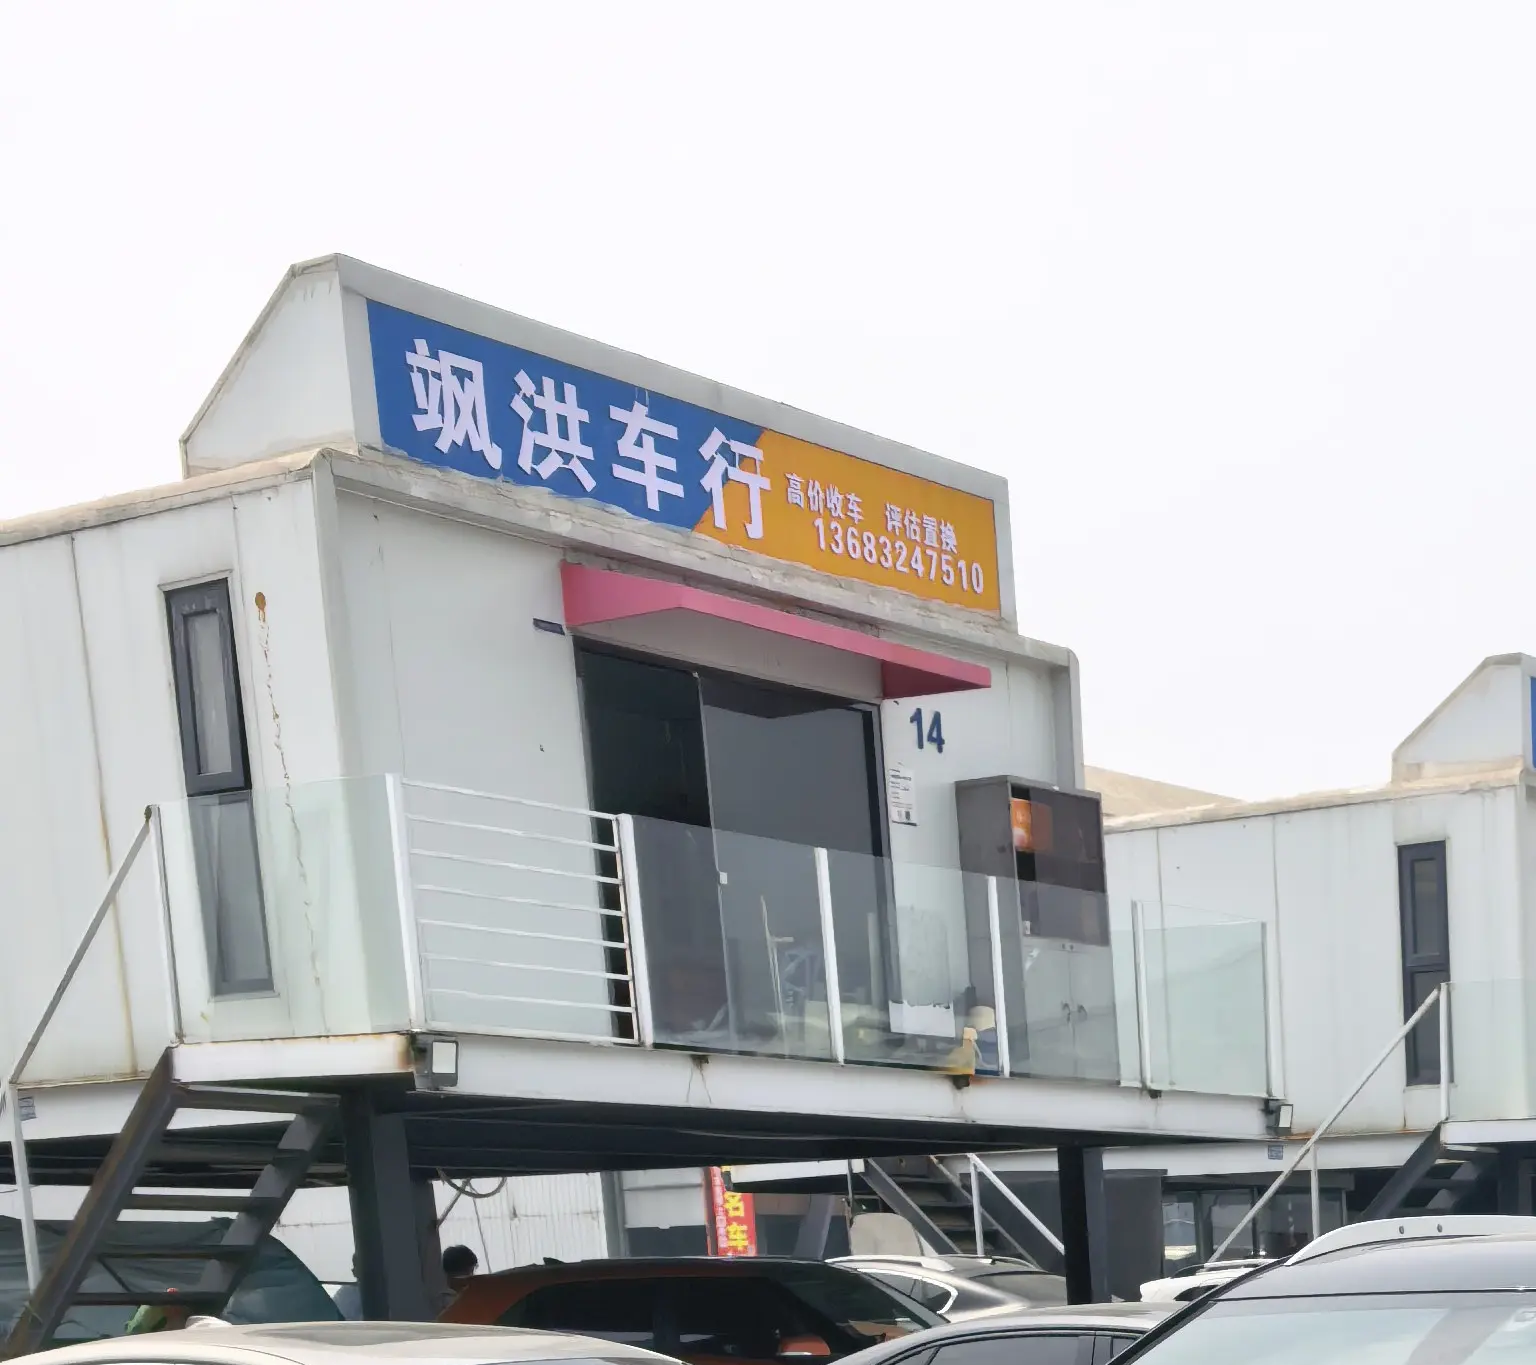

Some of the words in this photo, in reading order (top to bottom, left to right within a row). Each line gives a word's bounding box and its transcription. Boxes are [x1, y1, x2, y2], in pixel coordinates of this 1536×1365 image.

[406, 339, 771, 540] 飒洪车行
[785, 473, 864, 524] 高价收车
[885, 502, 958, 554] 评估置换
[813, 518, 985, 594] 13683247510
[909, 707, 946, 754] 14
